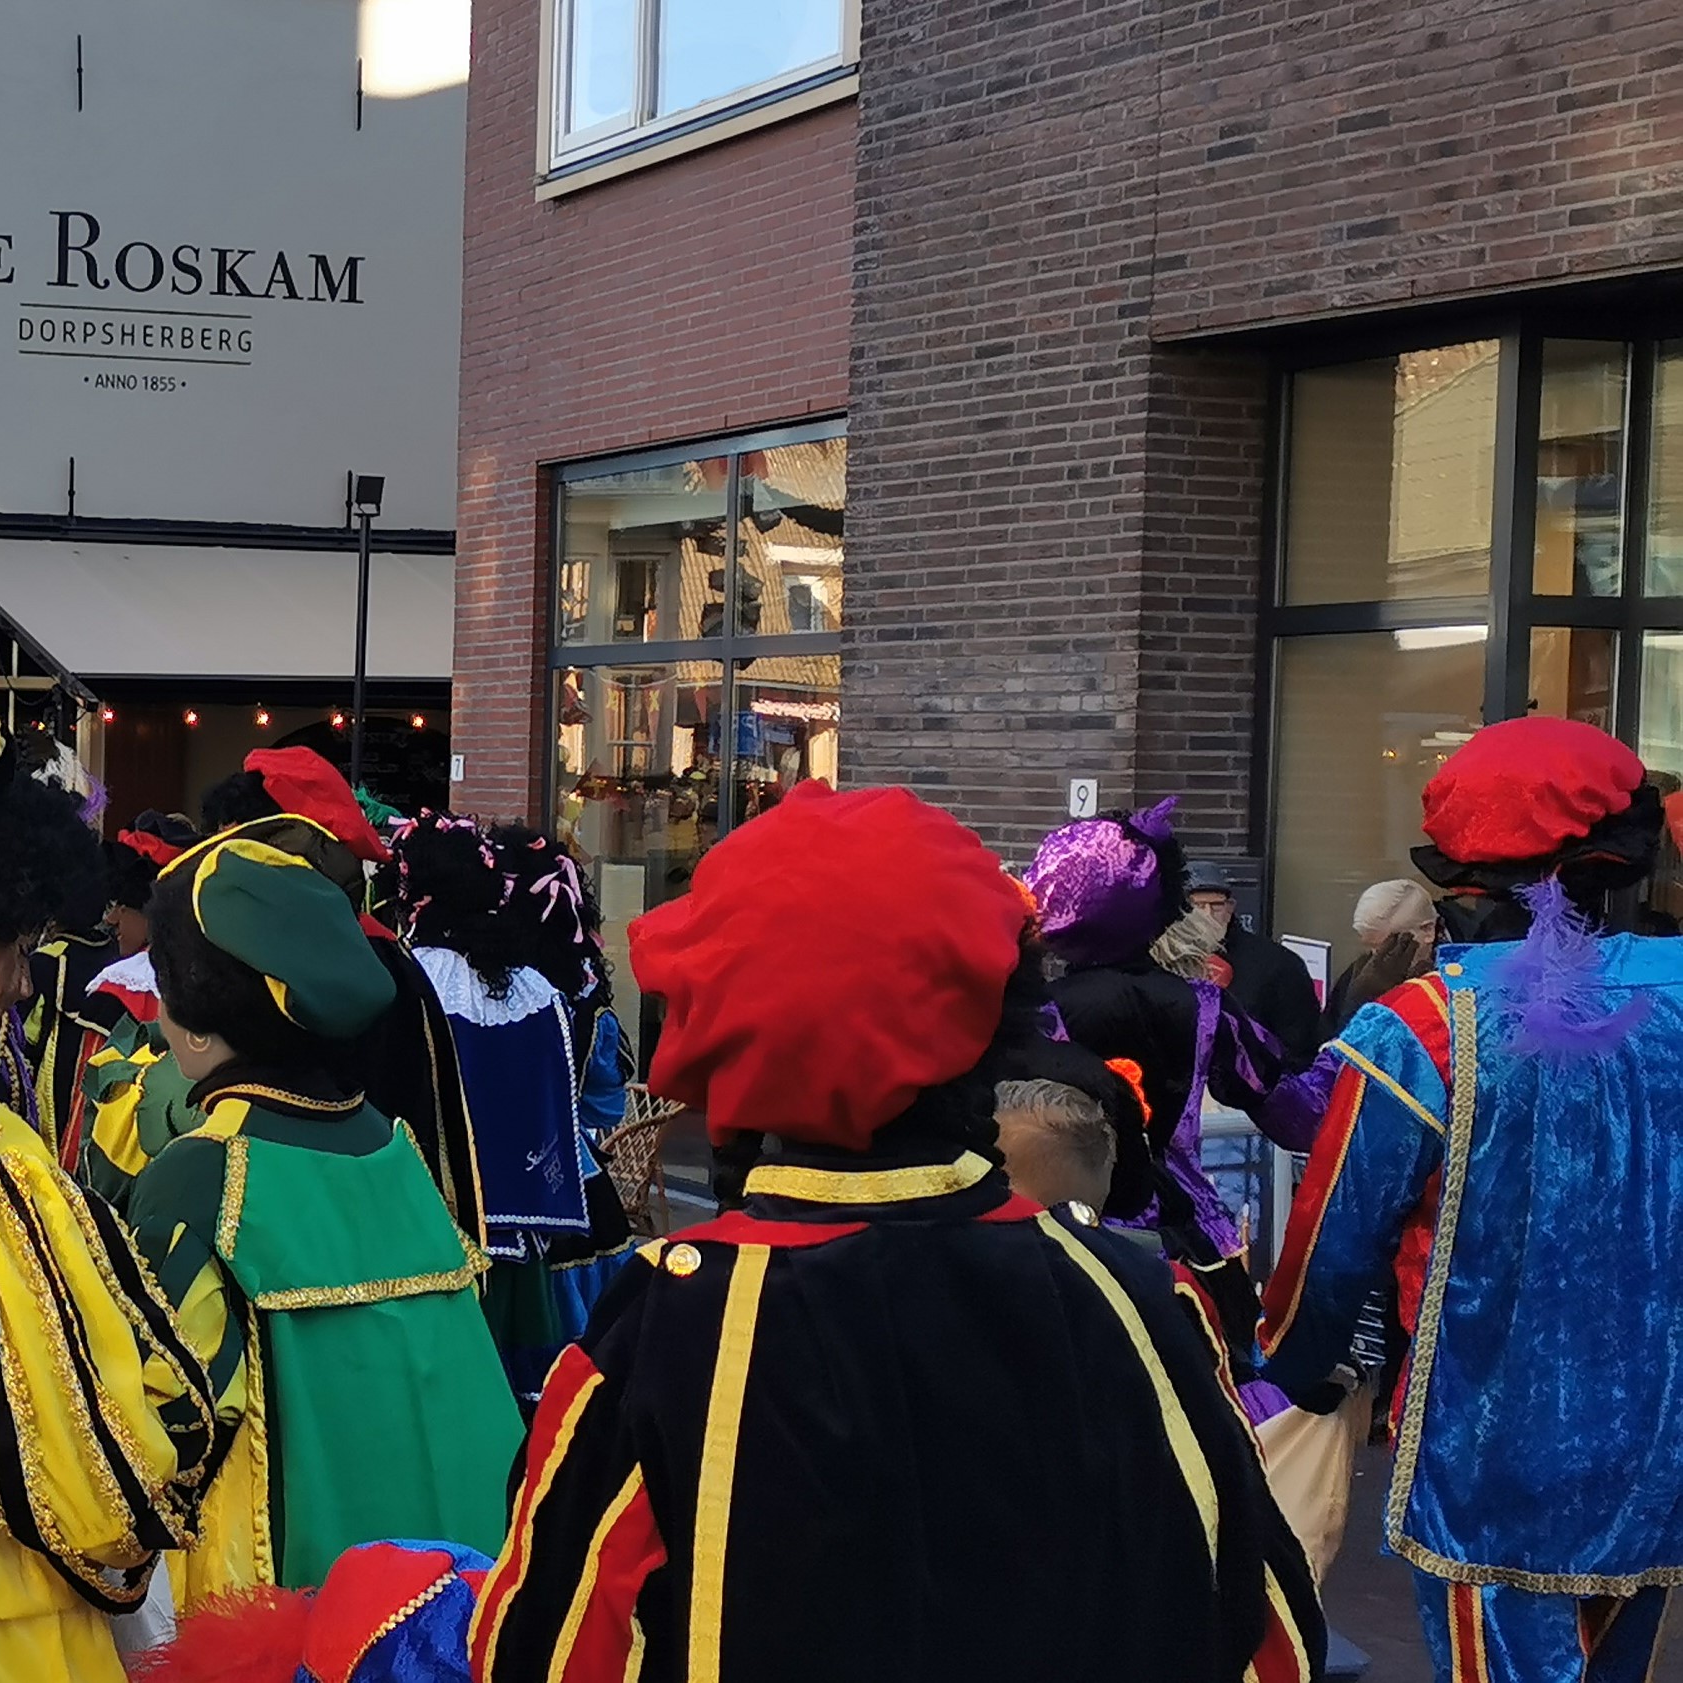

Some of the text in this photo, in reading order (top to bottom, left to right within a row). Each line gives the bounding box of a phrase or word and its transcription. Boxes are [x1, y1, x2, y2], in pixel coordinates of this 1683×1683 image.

[18, 317, 254, 354] DORPSHERBERG
[94, 373, 177, 392] ANNO 1855
[454, 757, 461, 778] 7
[1077, 784, 1089, 812] 9
